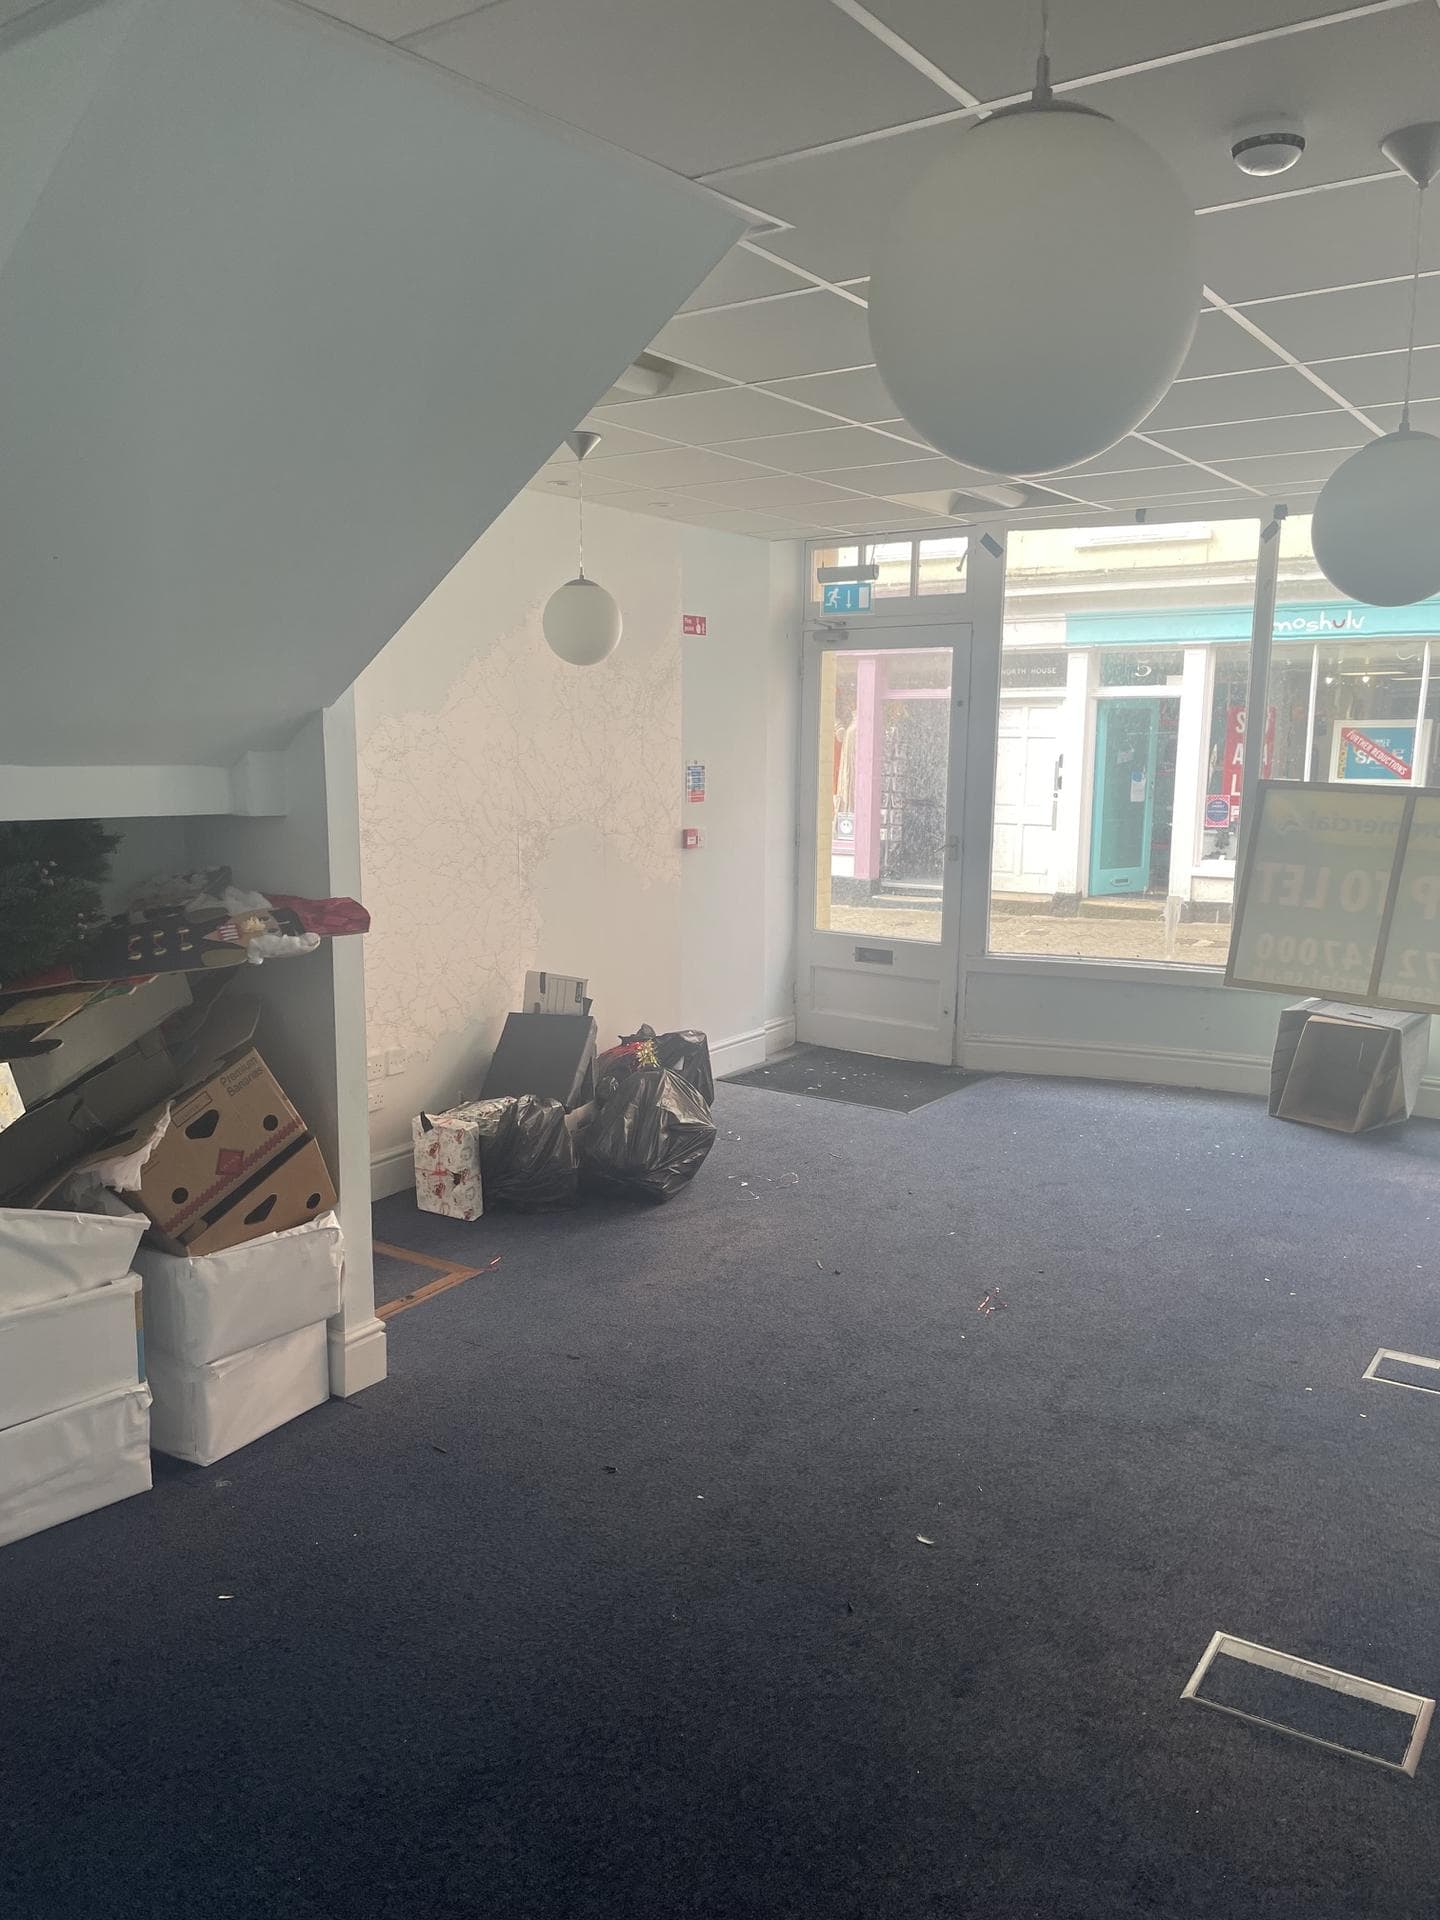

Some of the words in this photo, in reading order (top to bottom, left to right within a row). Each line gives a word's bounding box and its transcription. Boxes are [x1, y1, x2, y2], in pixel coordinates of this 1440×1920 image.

[1030, 666, 1057, 675] HOUSE
[1135, 661, 1152, 677] 5
[1345, 729, 1373, 752] FURTHER
[1370, 747, 1409, 776] REDUCTIONS
[220, 1056, 259, 1086] Premium
[226, 1066, 263, 1097] Bananas
